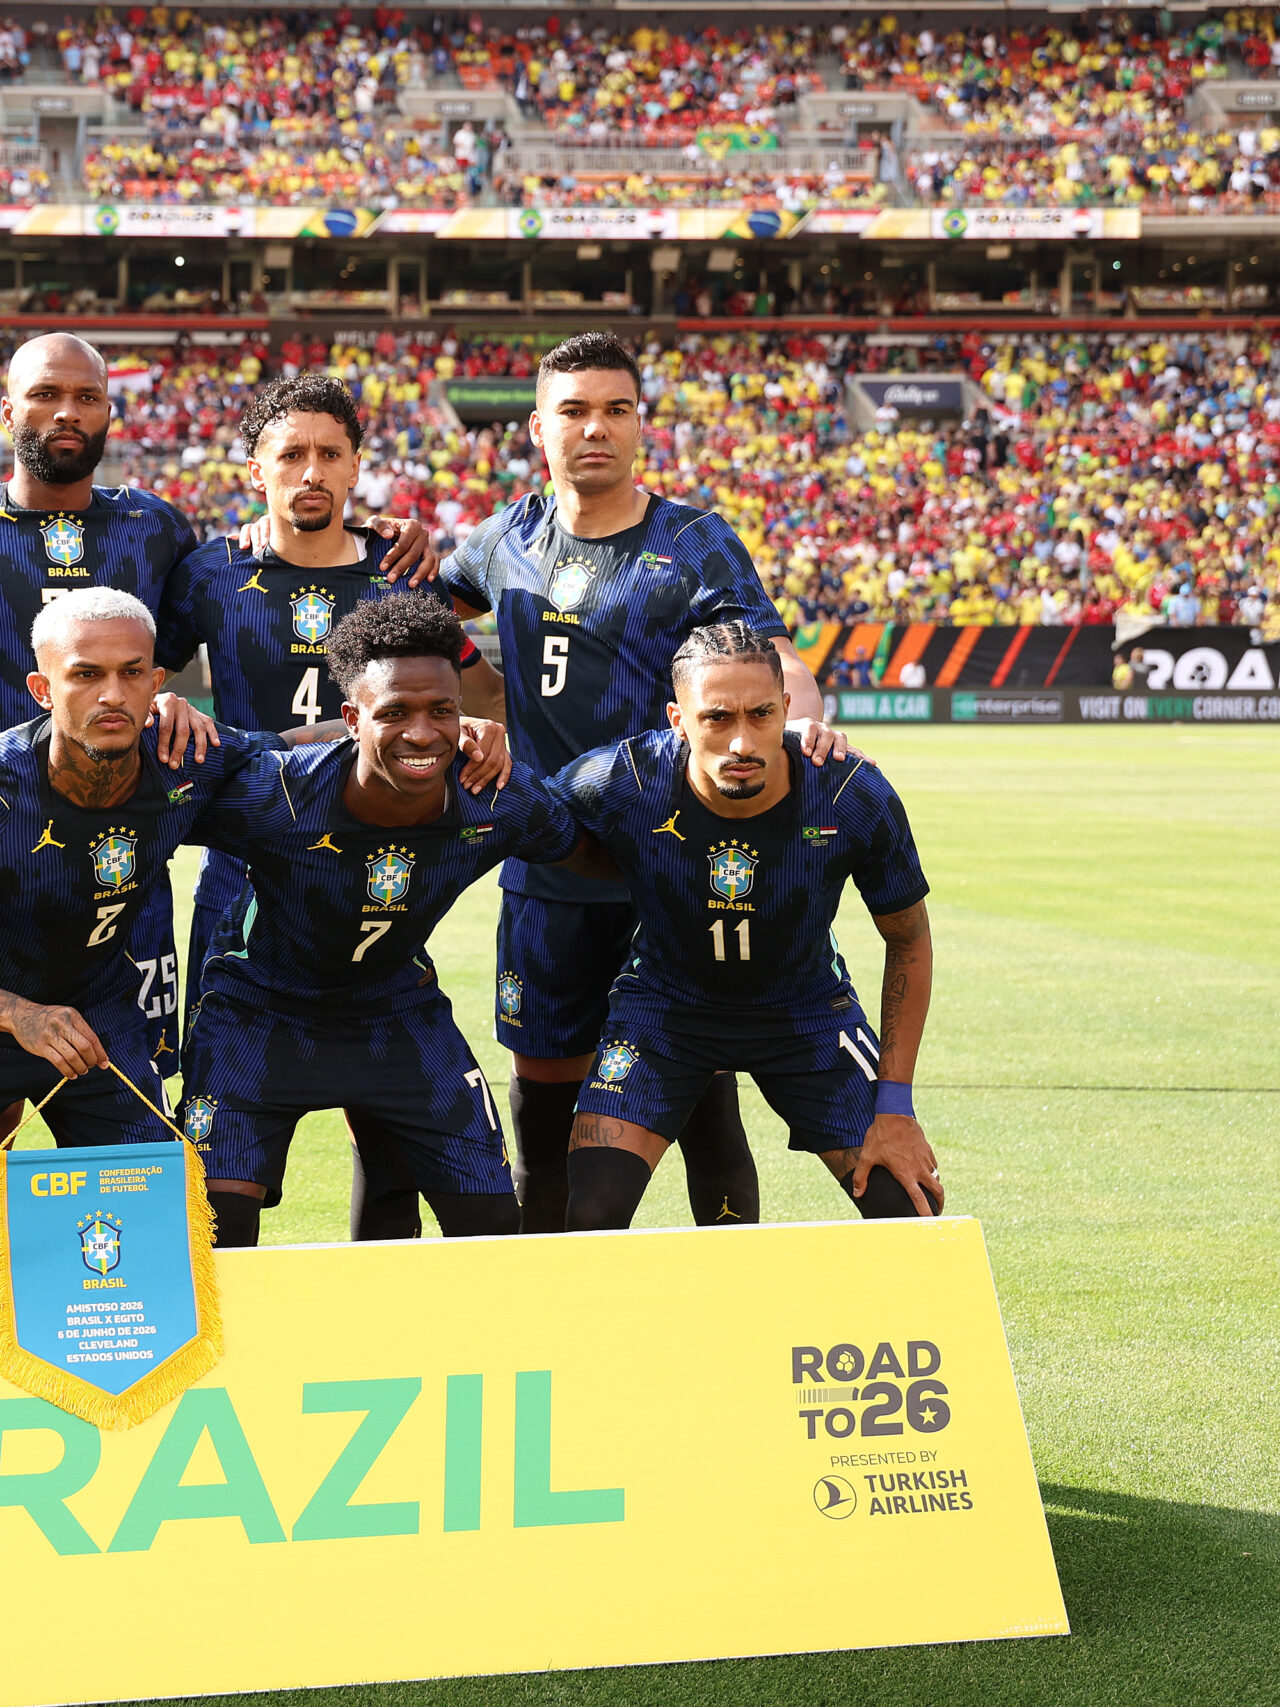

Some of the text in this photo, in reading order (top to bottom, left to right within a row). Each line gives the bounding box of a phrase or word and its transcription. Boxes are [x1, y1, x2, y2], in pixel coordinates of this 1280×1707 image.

[48, 567, 90, 577] BRASIL
[541, 611, 580, 625] BRASIL
[290, 644, 330, 654] BRASI
[541, 635, 570, 697] 5
[291, 667, 322, 726] 4
[841, 694, 875, 720] WIN
[877, 694, 891, 720] A
[894, 694, 931, 720] CAR
[1079, 696, 1121, 719] VISIT
[106, 855, 123, 865] CBF
[723, 869, 741, 877] CBF
[93, 881, 139, 900] BRASIL
[361, 904, 408, 913] BRASIL
[707, 900, 756, 911] BRASIL
[86, 902, 126, 947] 2
[351, 921, 392, 962] 7
[708, 918, 751, 961] 11
[500, 1013, 523, 1028] BRASIL
[839, 1027, 880, 1082] 11
[590, 1081, 624, 1094] BRASIL
[463, 1068, 498, 1131] 7
[99, 1165, 163, 1178] CONFEDERAÇÃO
[30, 1171, 87, 1197] CBF
[99, 1176, 146, 1185] BRASILEIRA
[100, 1184, 149, 1193] DE FUTEBOL
[92, 1242, 109, 1250] CBF
[83, 1277, 127, 1290] BRASIL
[66, 1301, 143, 1314] AMISTOSO 2026
[67, 1313, 145, 1326] BRASIL X EGITO
[57, 1325, 157, 1339] 6 DE JUNHO DE 2026
[78, 1339, 138, 1350] CLEVELAND
[66, 1350, 154, 1363] ESTADOS UNIDOS
[792, 1340, 941, 1384] ROAD
[798, 1407, 856, 1440] TO
[830, 1450, 938, 1467] PRESENTED BY
[864, 1469, 968, 1493] TURKISH
[869, 1491, 974, 1516] AIRLINES
